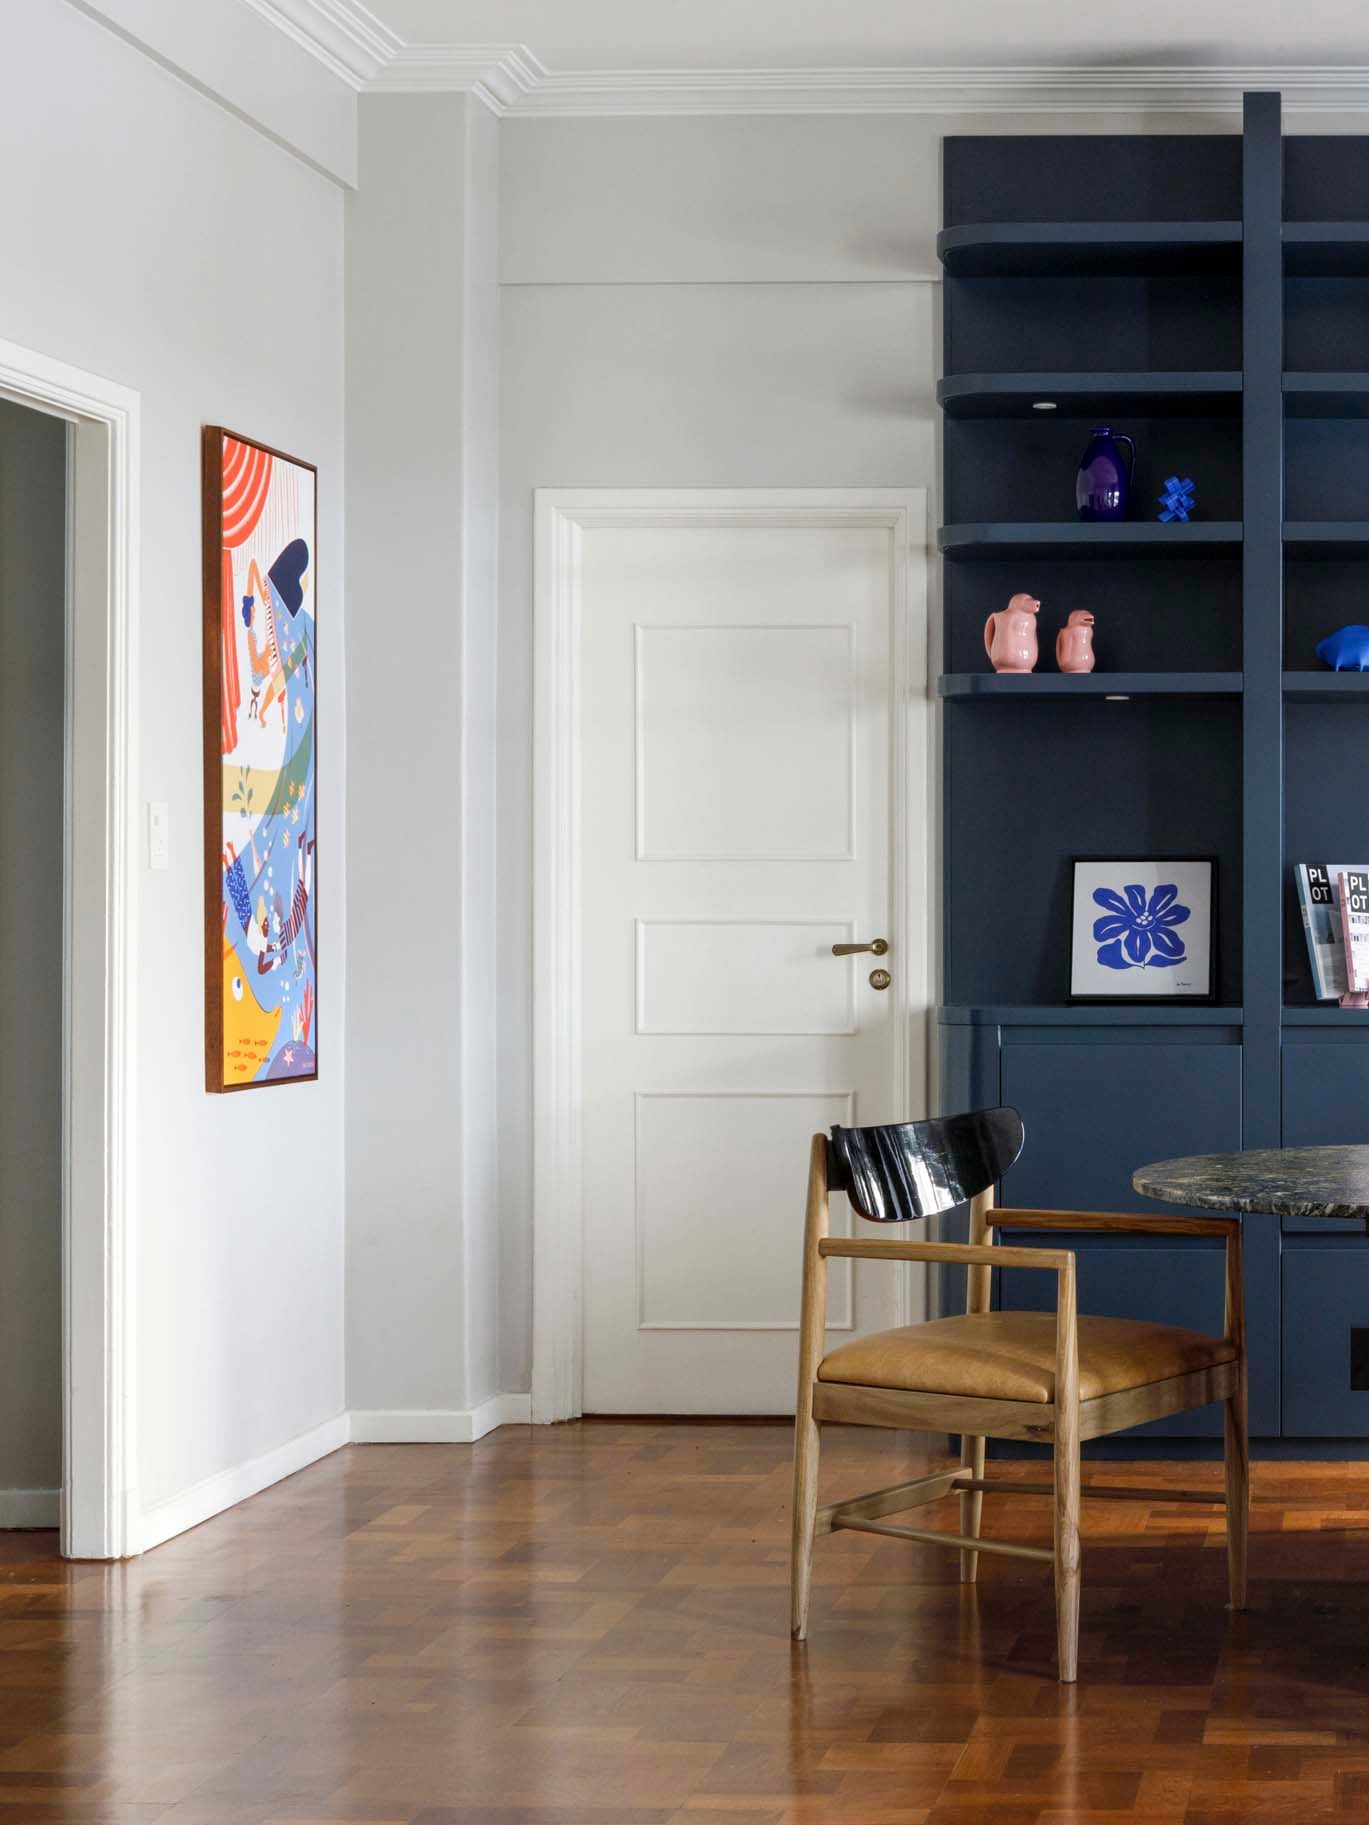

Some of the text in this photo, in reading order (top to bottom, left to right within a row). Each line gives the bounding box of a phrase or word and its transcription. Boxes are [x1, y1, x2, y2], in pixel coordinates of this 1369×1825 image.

[1308, 868, 1327, 883] PL
[1350, 876, 1367, 891] PL
[1311, 887, 1328, 901] OT
[1351, 895, 1367, 910] OT
